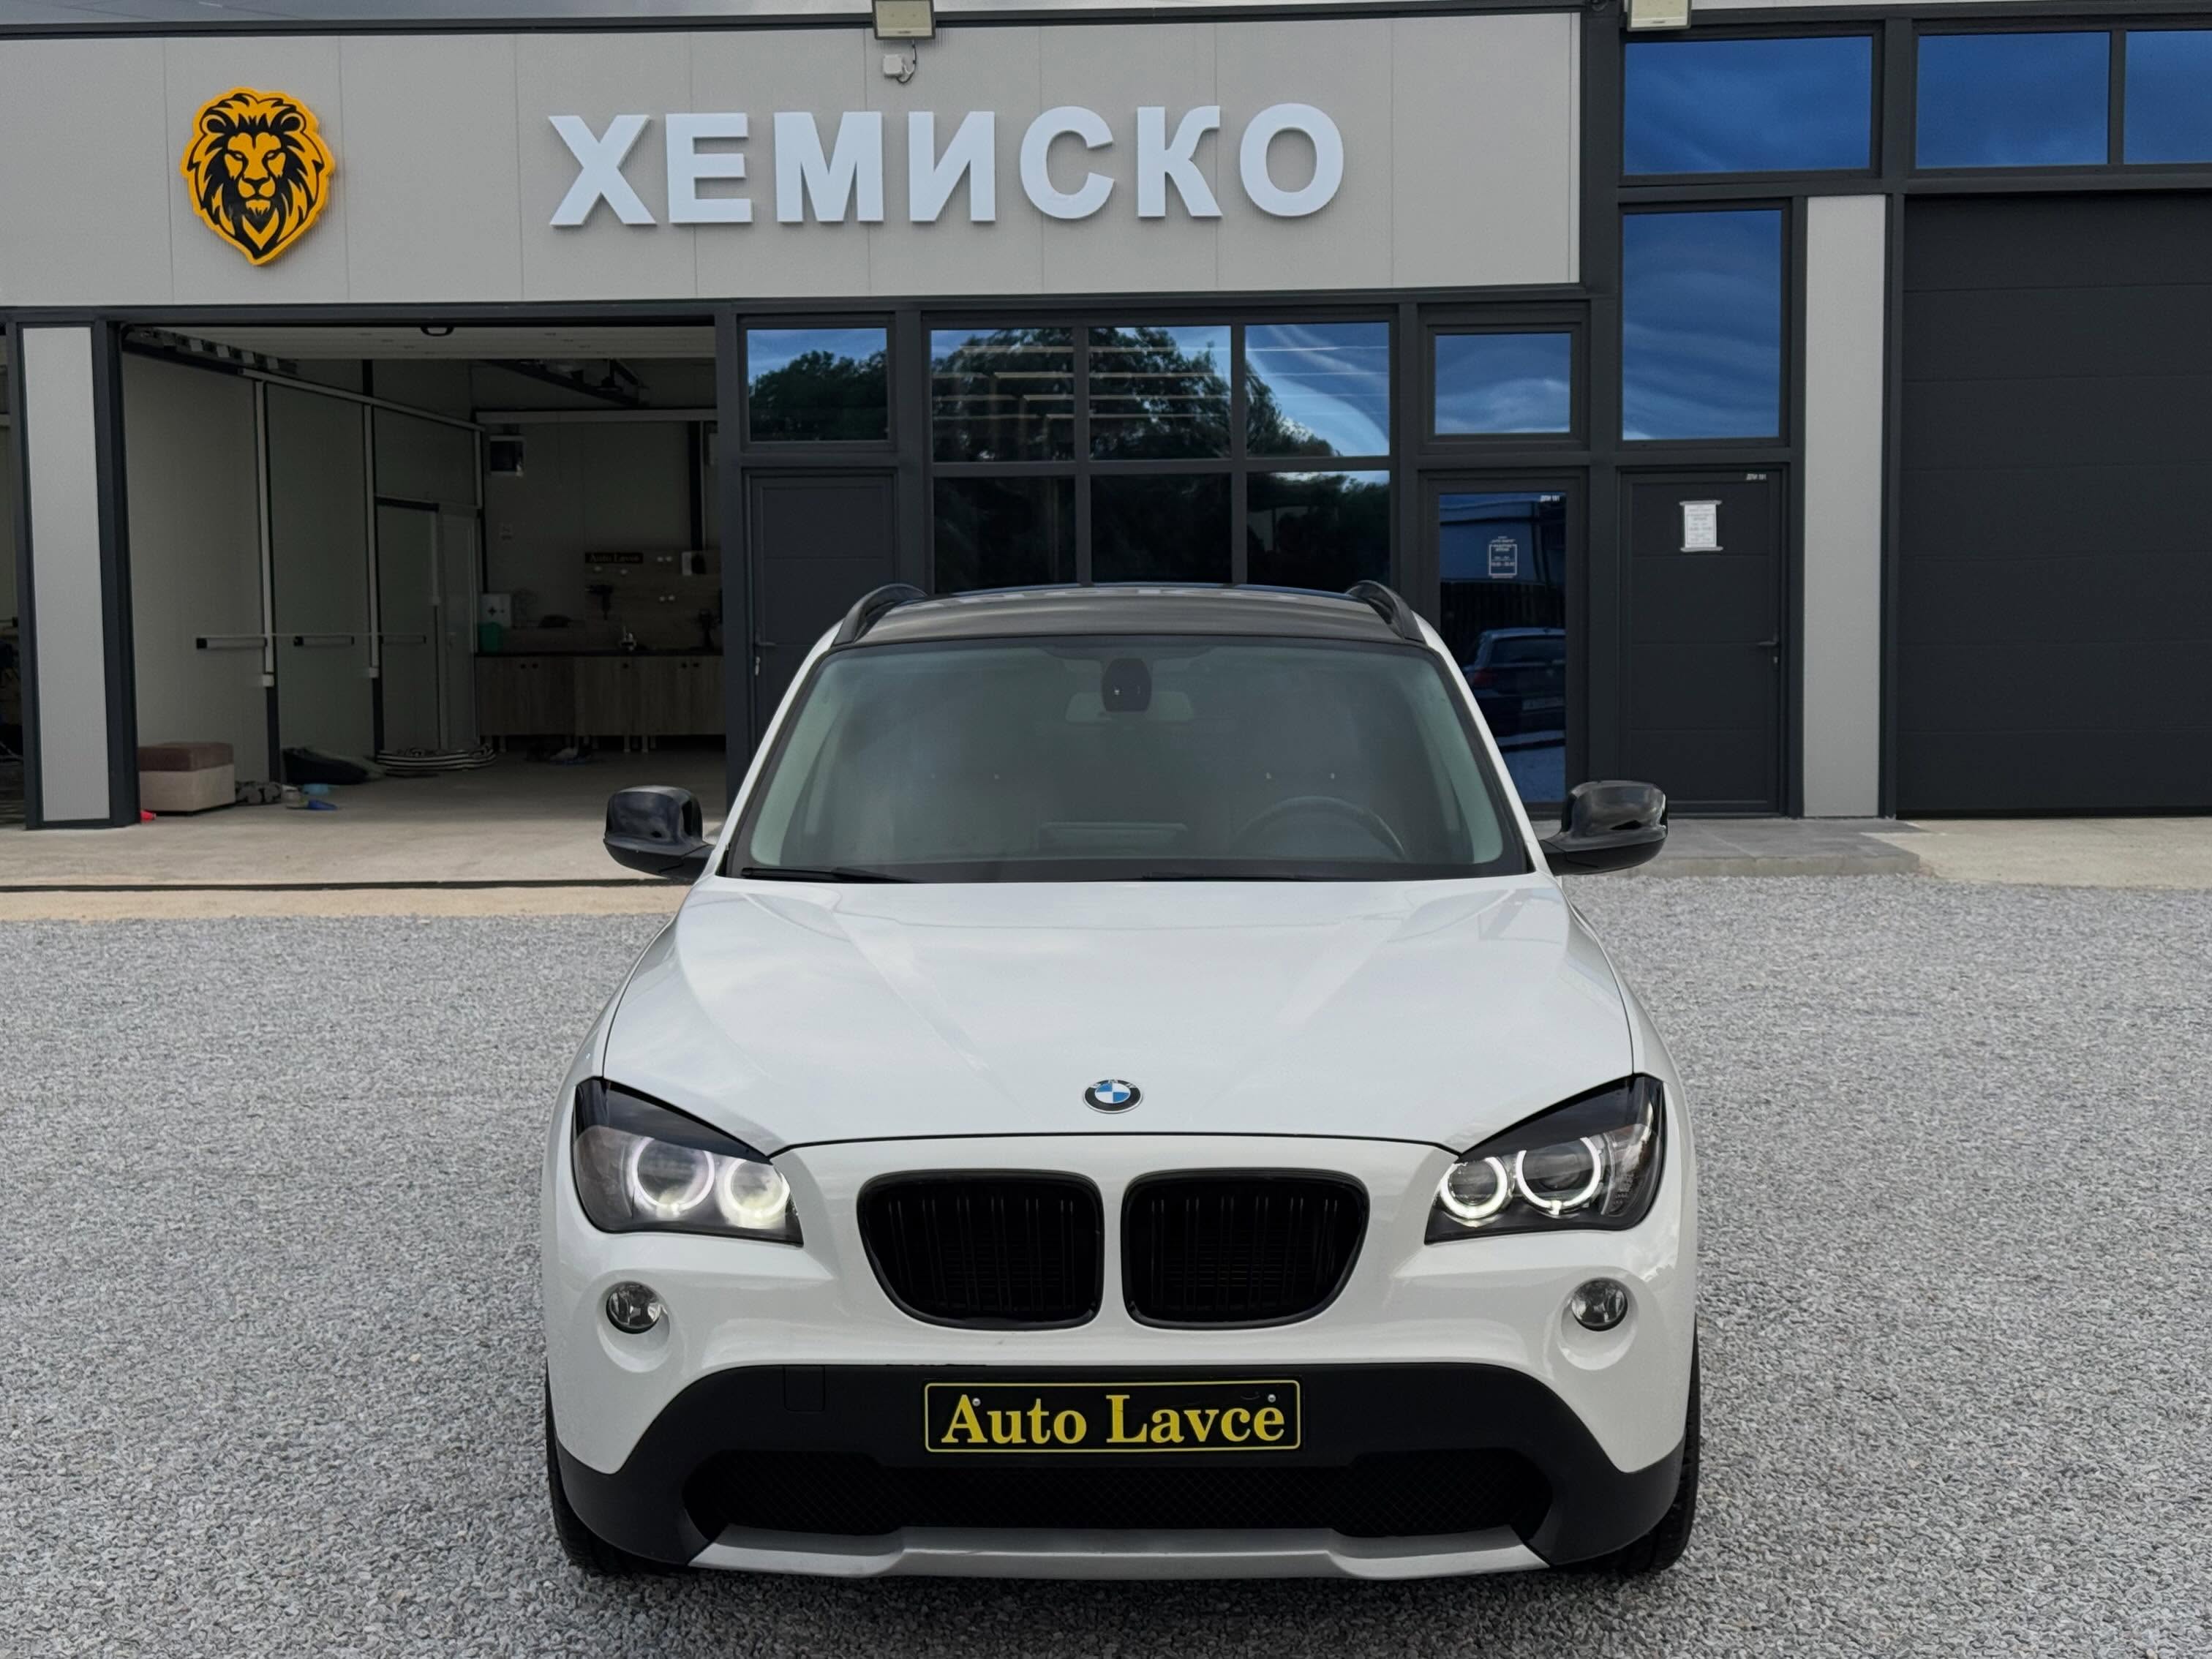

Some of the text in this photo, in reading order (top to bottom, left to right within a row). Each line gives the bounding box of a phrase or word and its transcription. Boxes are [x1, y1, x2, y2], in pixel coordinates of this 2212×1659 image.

[549, 102, 1344, 225] ХЕМИСКО
[941, 1393, 1285, 1445] Auto Lavce
